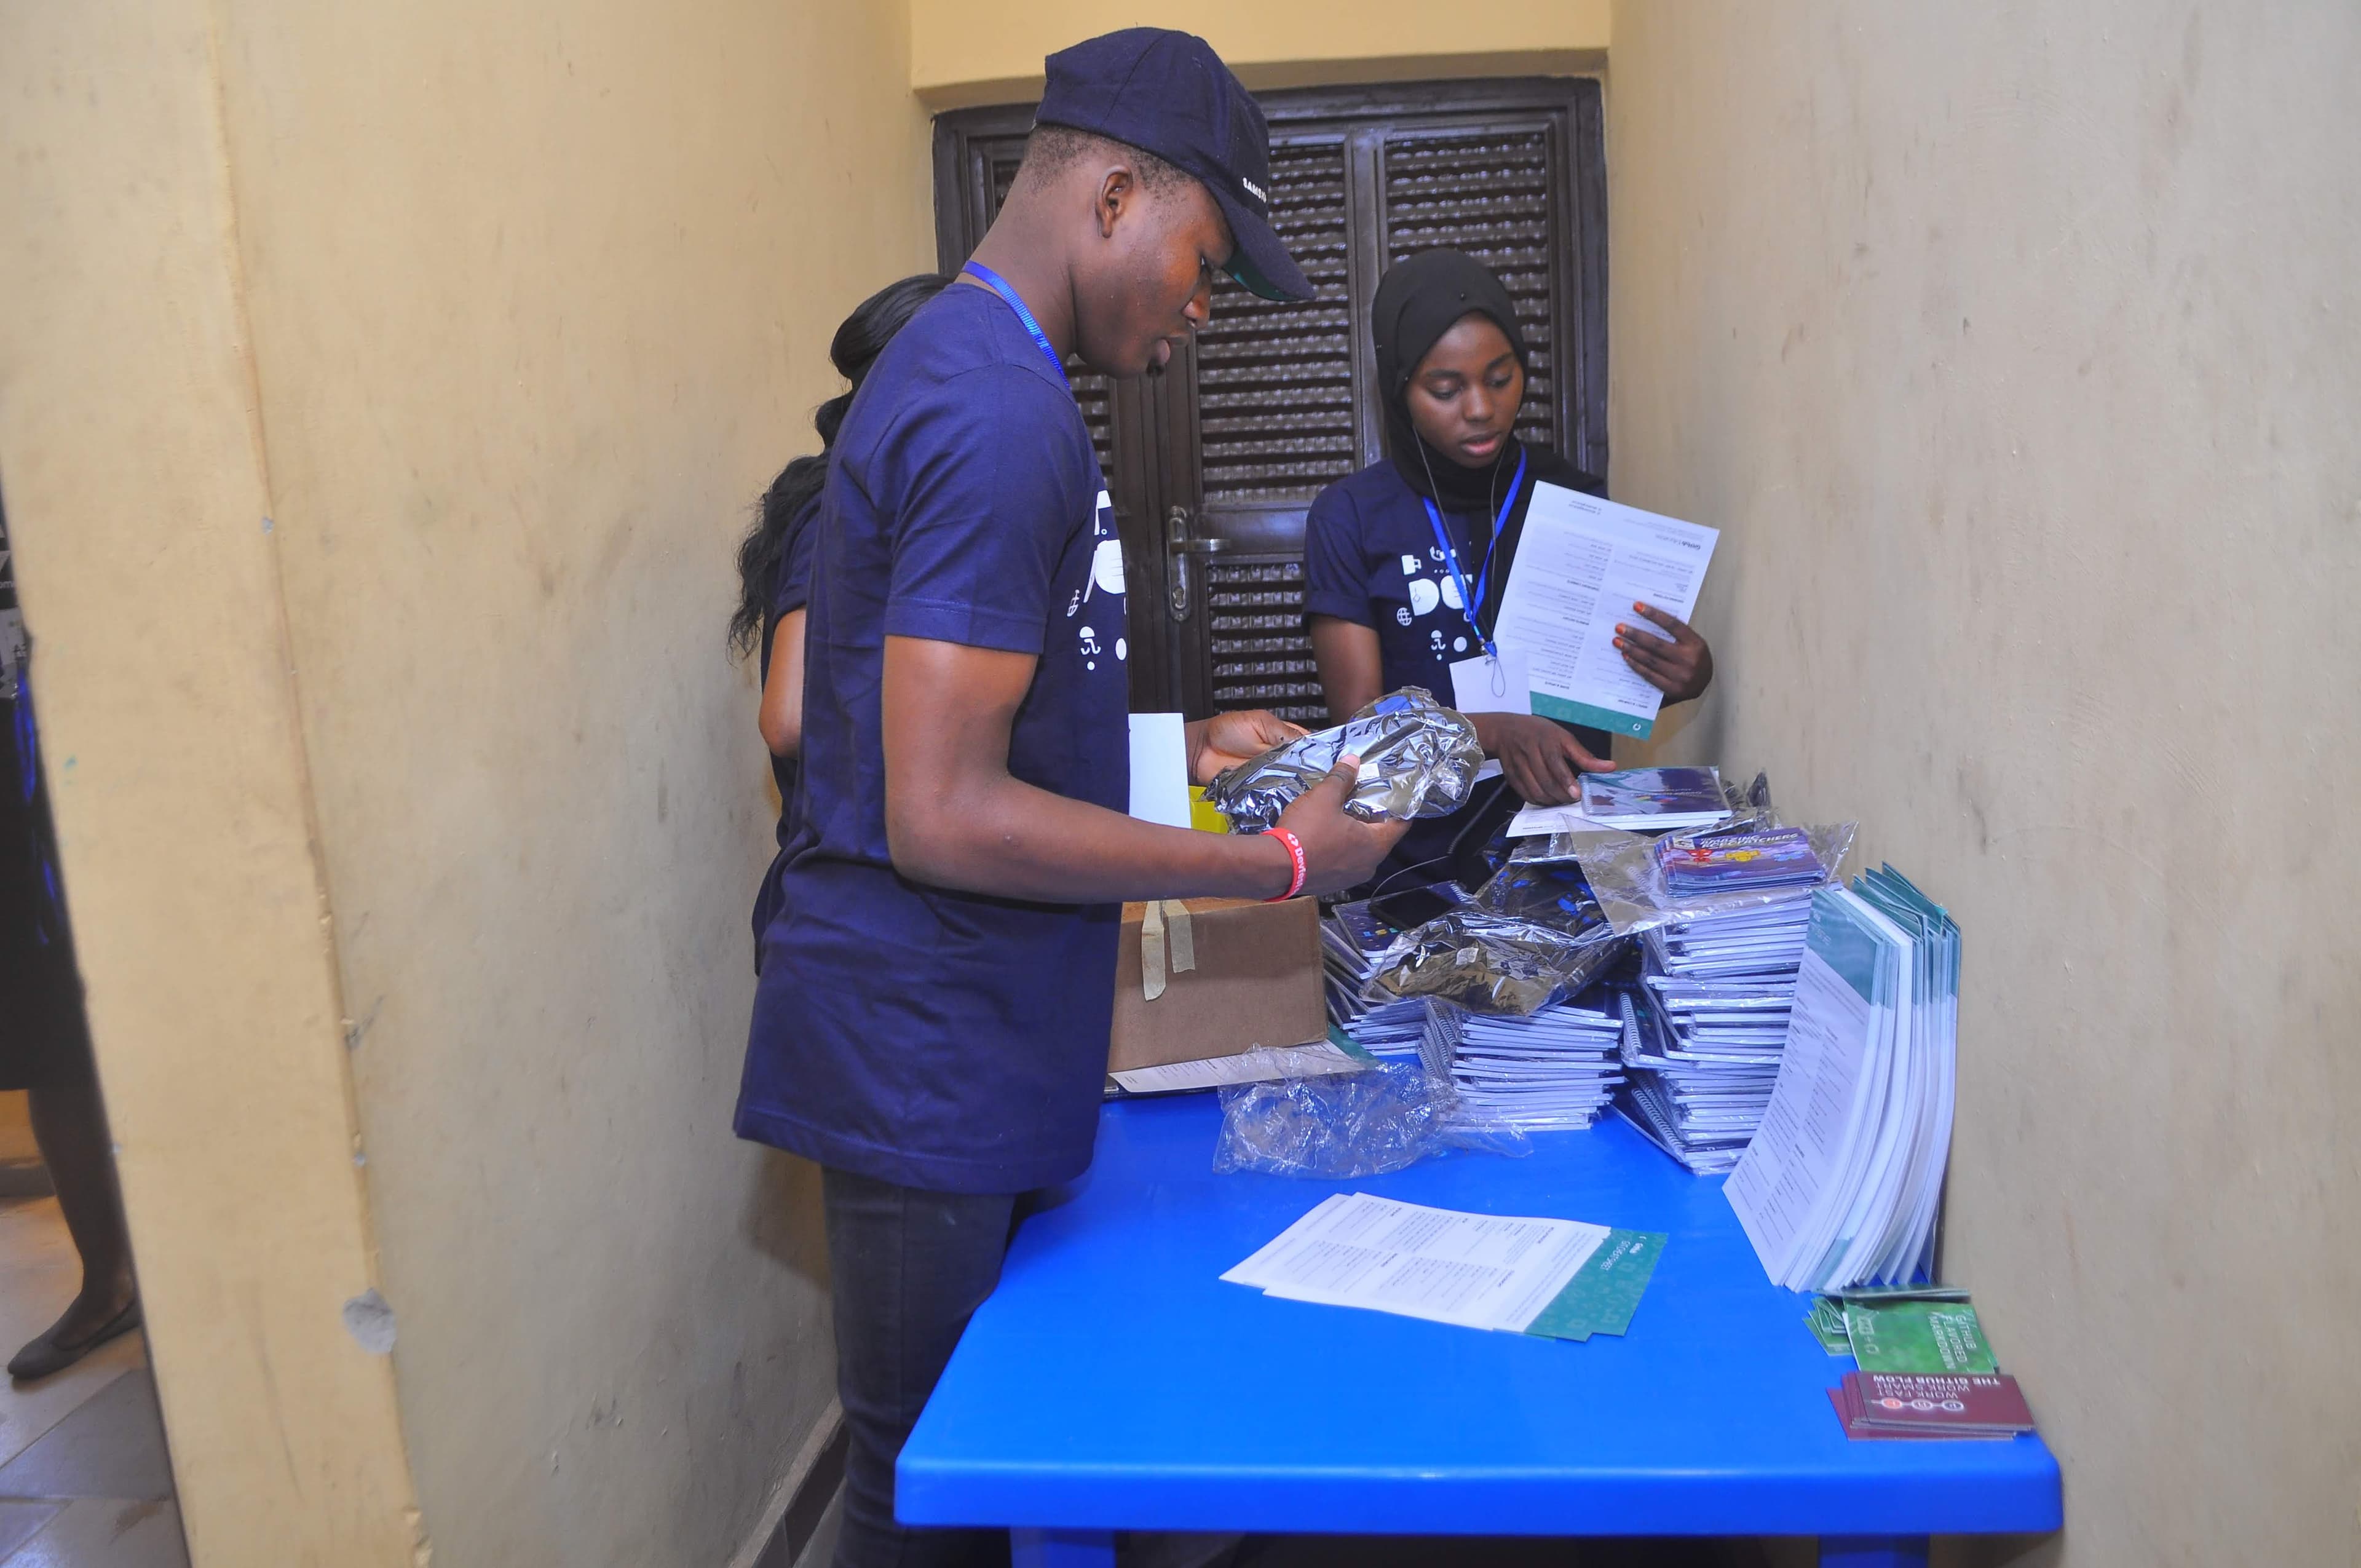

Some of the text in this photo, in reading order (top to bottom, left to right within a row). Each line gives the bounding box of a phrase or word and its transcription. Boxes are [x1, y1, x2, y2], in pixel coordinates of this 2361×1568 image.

[1928, 1315, 1956, 1369] MARKDOWN
[1943, 1315, 1968, 1361] FLAVORED
[1956, 1315, 1977, 1348] GITHUB
[1873, 1374, 2001, 1386] THE GITHUB FLOW
[1877, 1382, 1971, 1393] WORK SMART
[1878, 1388, 1958, 1399] WORK FAST
